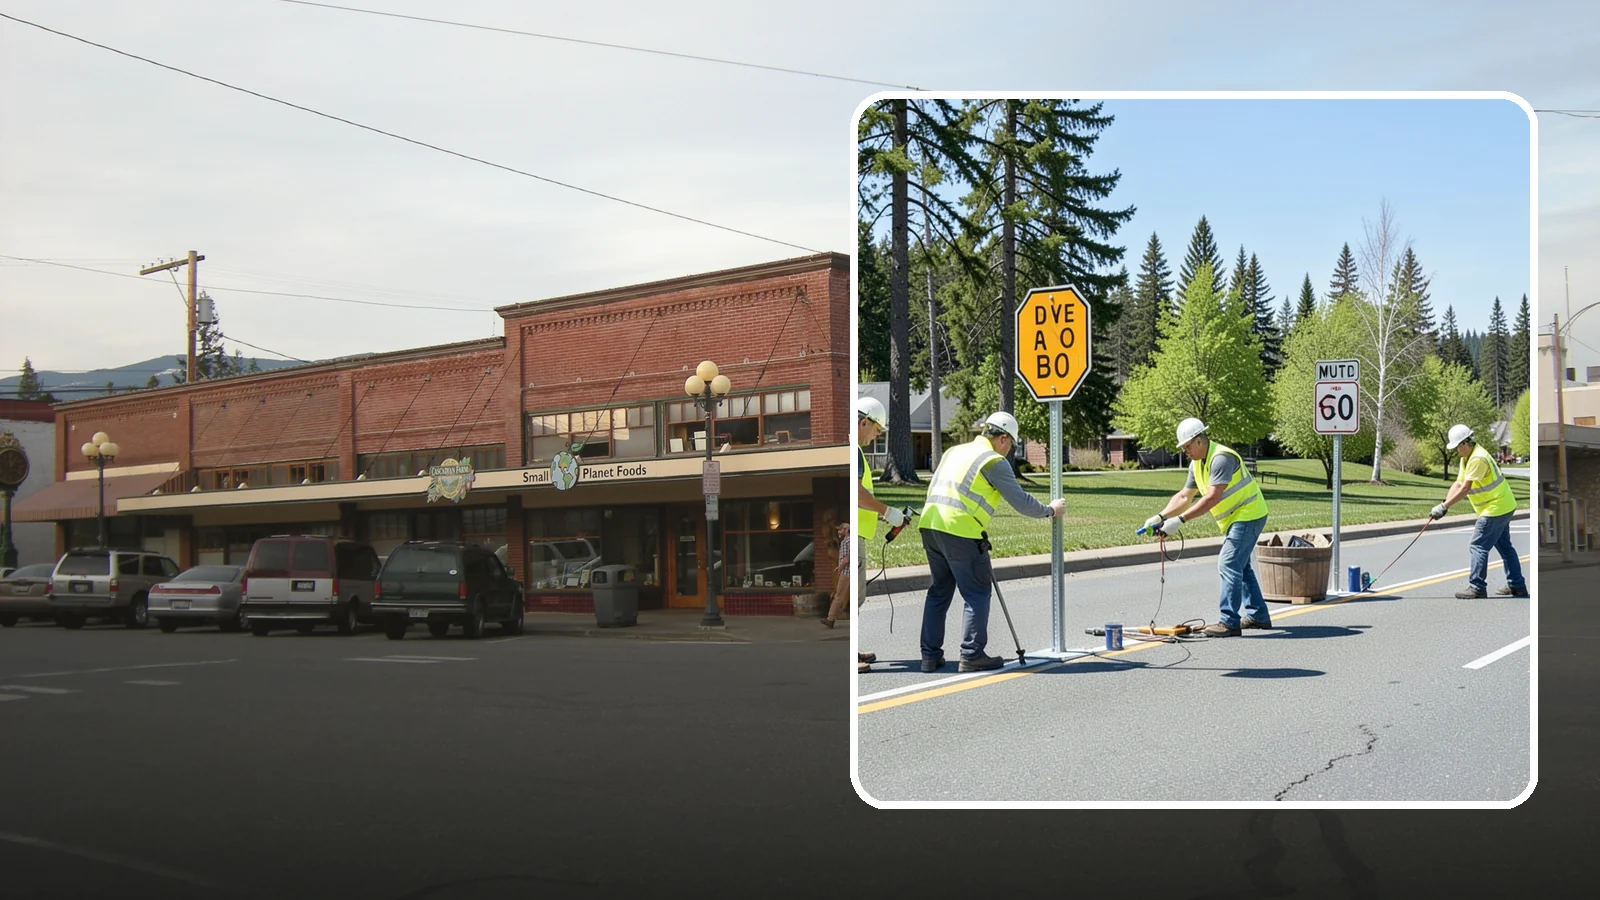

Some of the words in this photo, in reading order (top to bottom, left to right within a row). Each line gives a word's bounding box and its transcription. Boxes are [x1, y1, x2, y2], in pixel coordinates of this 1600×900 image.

[1034, 330, 1047, 351] A
[1037, 352, 1070, 379] BO
[1319, 393, 1354, 421] 60
[522, 470, 549, 483] Small
[582, 467, 614, 479] Planet
[616, 464, 647, 477] Foods
